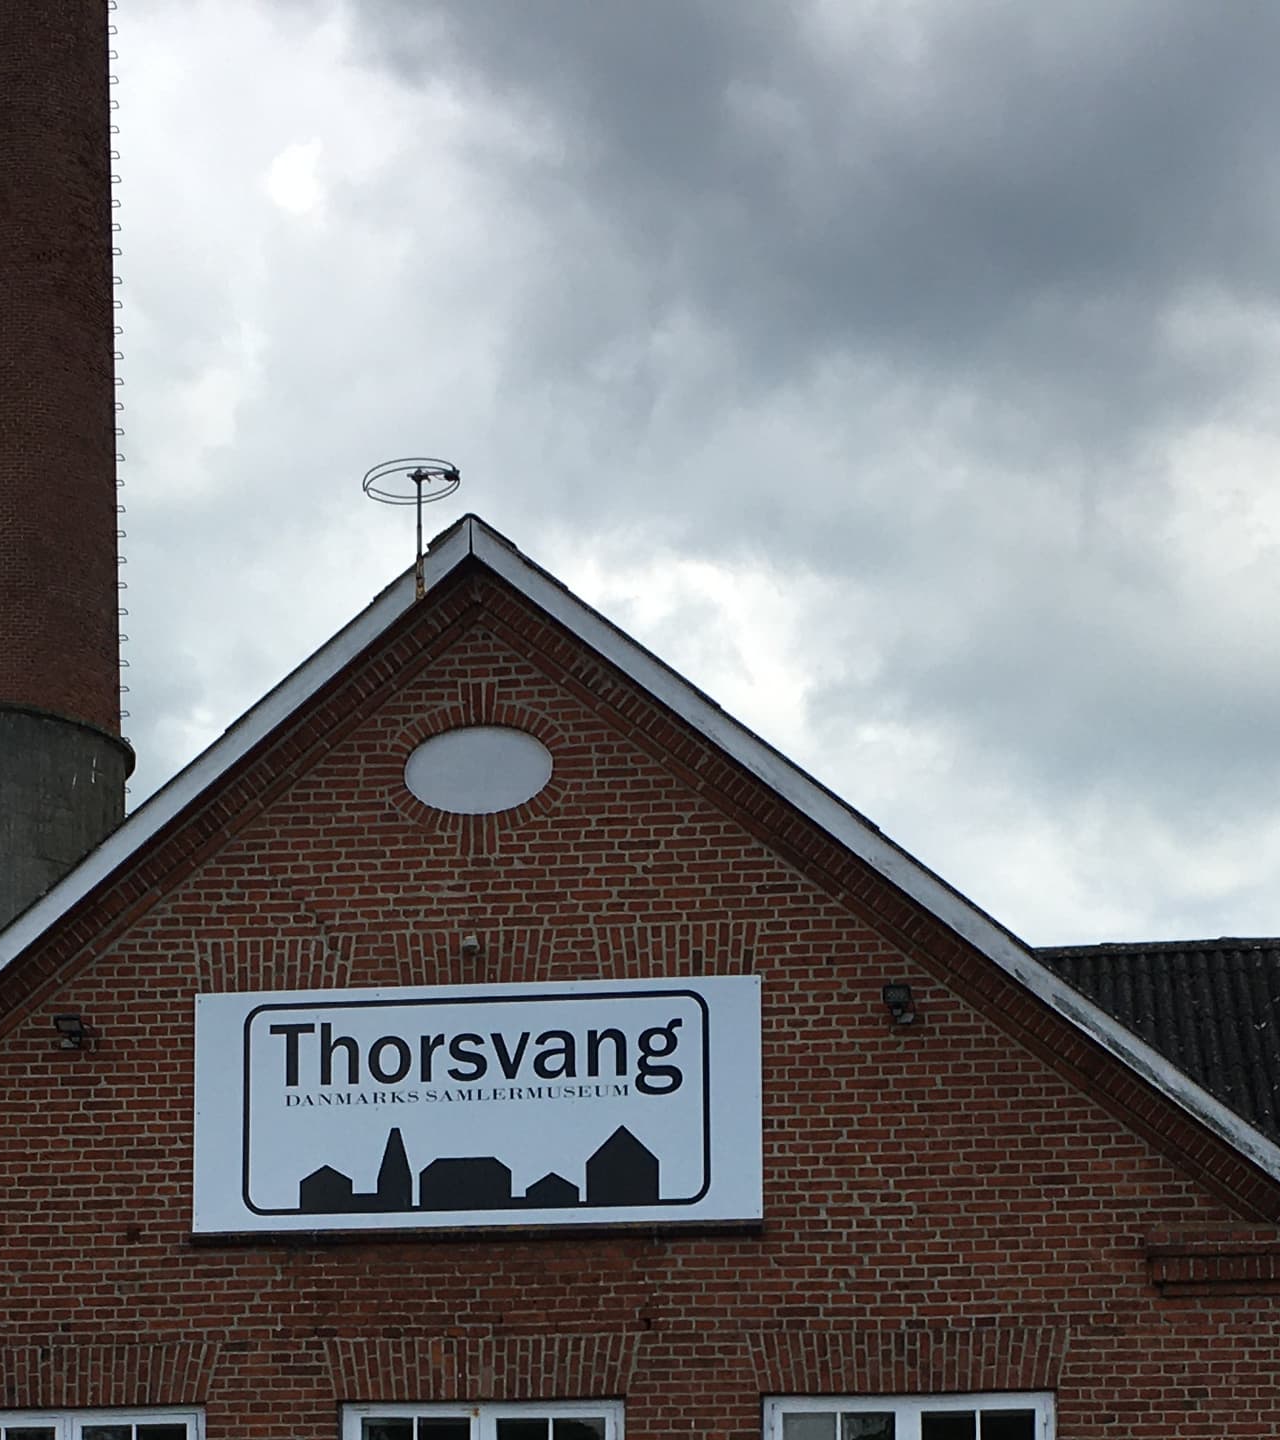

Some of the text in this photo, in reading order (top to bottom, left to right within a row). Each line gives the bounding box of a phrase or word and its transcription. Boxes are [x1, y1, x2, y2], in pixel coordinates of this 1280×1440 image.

[269, 1018, 683, 1096] Thorsvang
[284, 1083, 631, 1108] DANMARKS SAMLERMUSEUM
